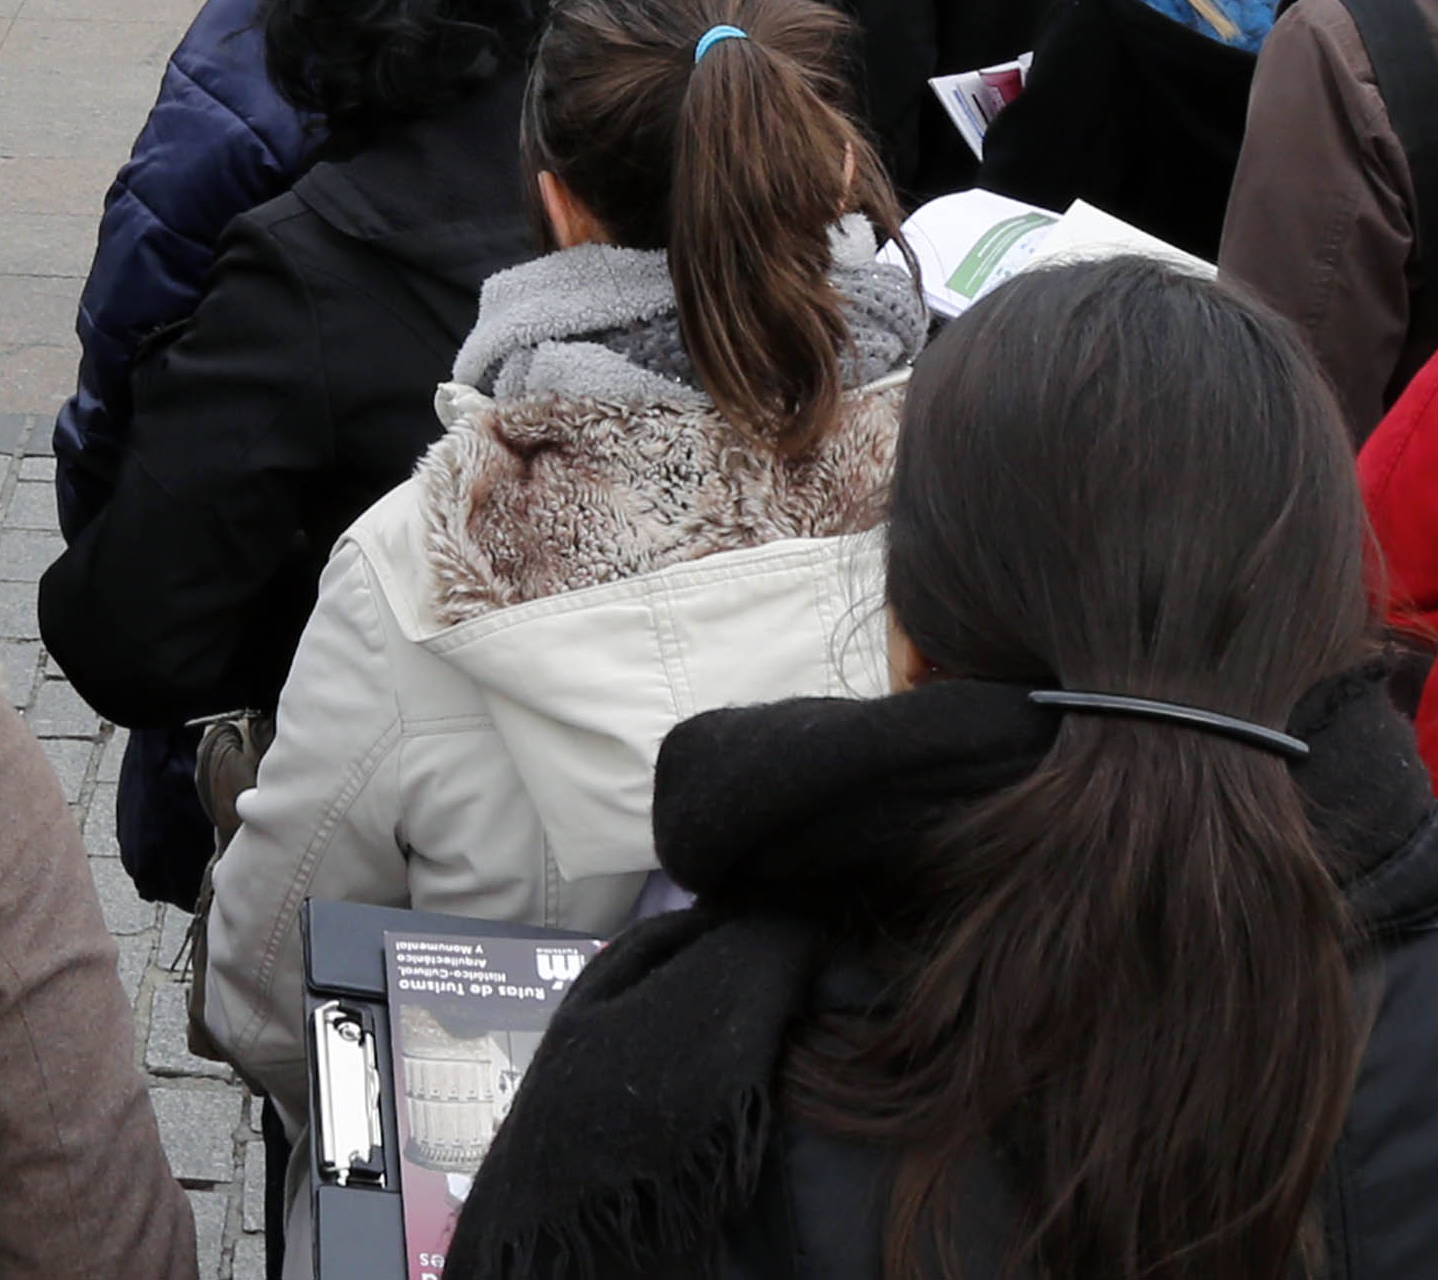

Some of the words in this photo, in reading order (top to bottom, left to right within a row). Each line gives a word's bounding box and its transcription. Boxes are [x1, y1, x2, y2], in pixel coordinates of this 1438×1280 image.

[395, 941, 474, 955] Monumental
[475, 944, 484, 954] y
[399, 978, 465, 995] Turismo
[470, 983, 493, 997] de
[499, 986, 546, 1000] Rutas
